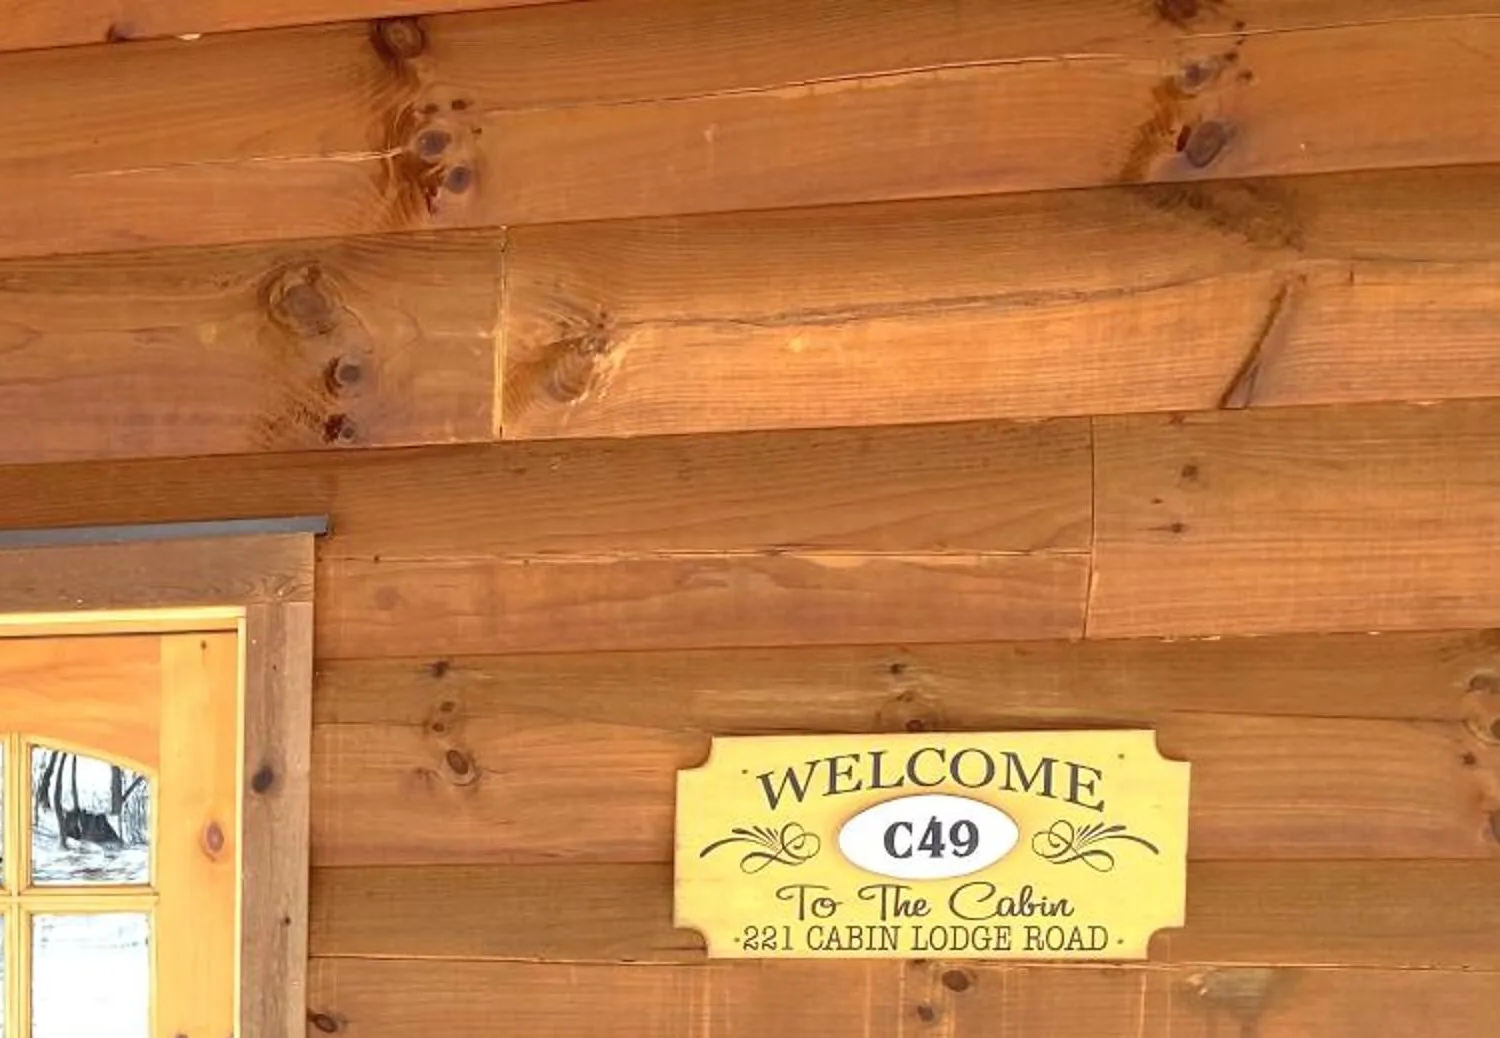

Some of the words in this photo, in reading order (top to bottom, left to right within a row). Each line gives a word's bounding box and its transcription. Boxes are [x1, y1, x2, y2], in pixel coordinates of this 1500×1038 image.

[756, 747, 1106, 813] WELCOME
[883, 816, 980, 859] C49
[775, 883, 838, 921] To
[858, 883, 931, 920] The
[949, 881, 1075, 921] Cabin
[742, 926, 793, 951] 221
[806, 926, 900, 951] CABIN
[910, 925, 1013, 951] LODGE
[1023, 925, 1110, 951] ROAD
